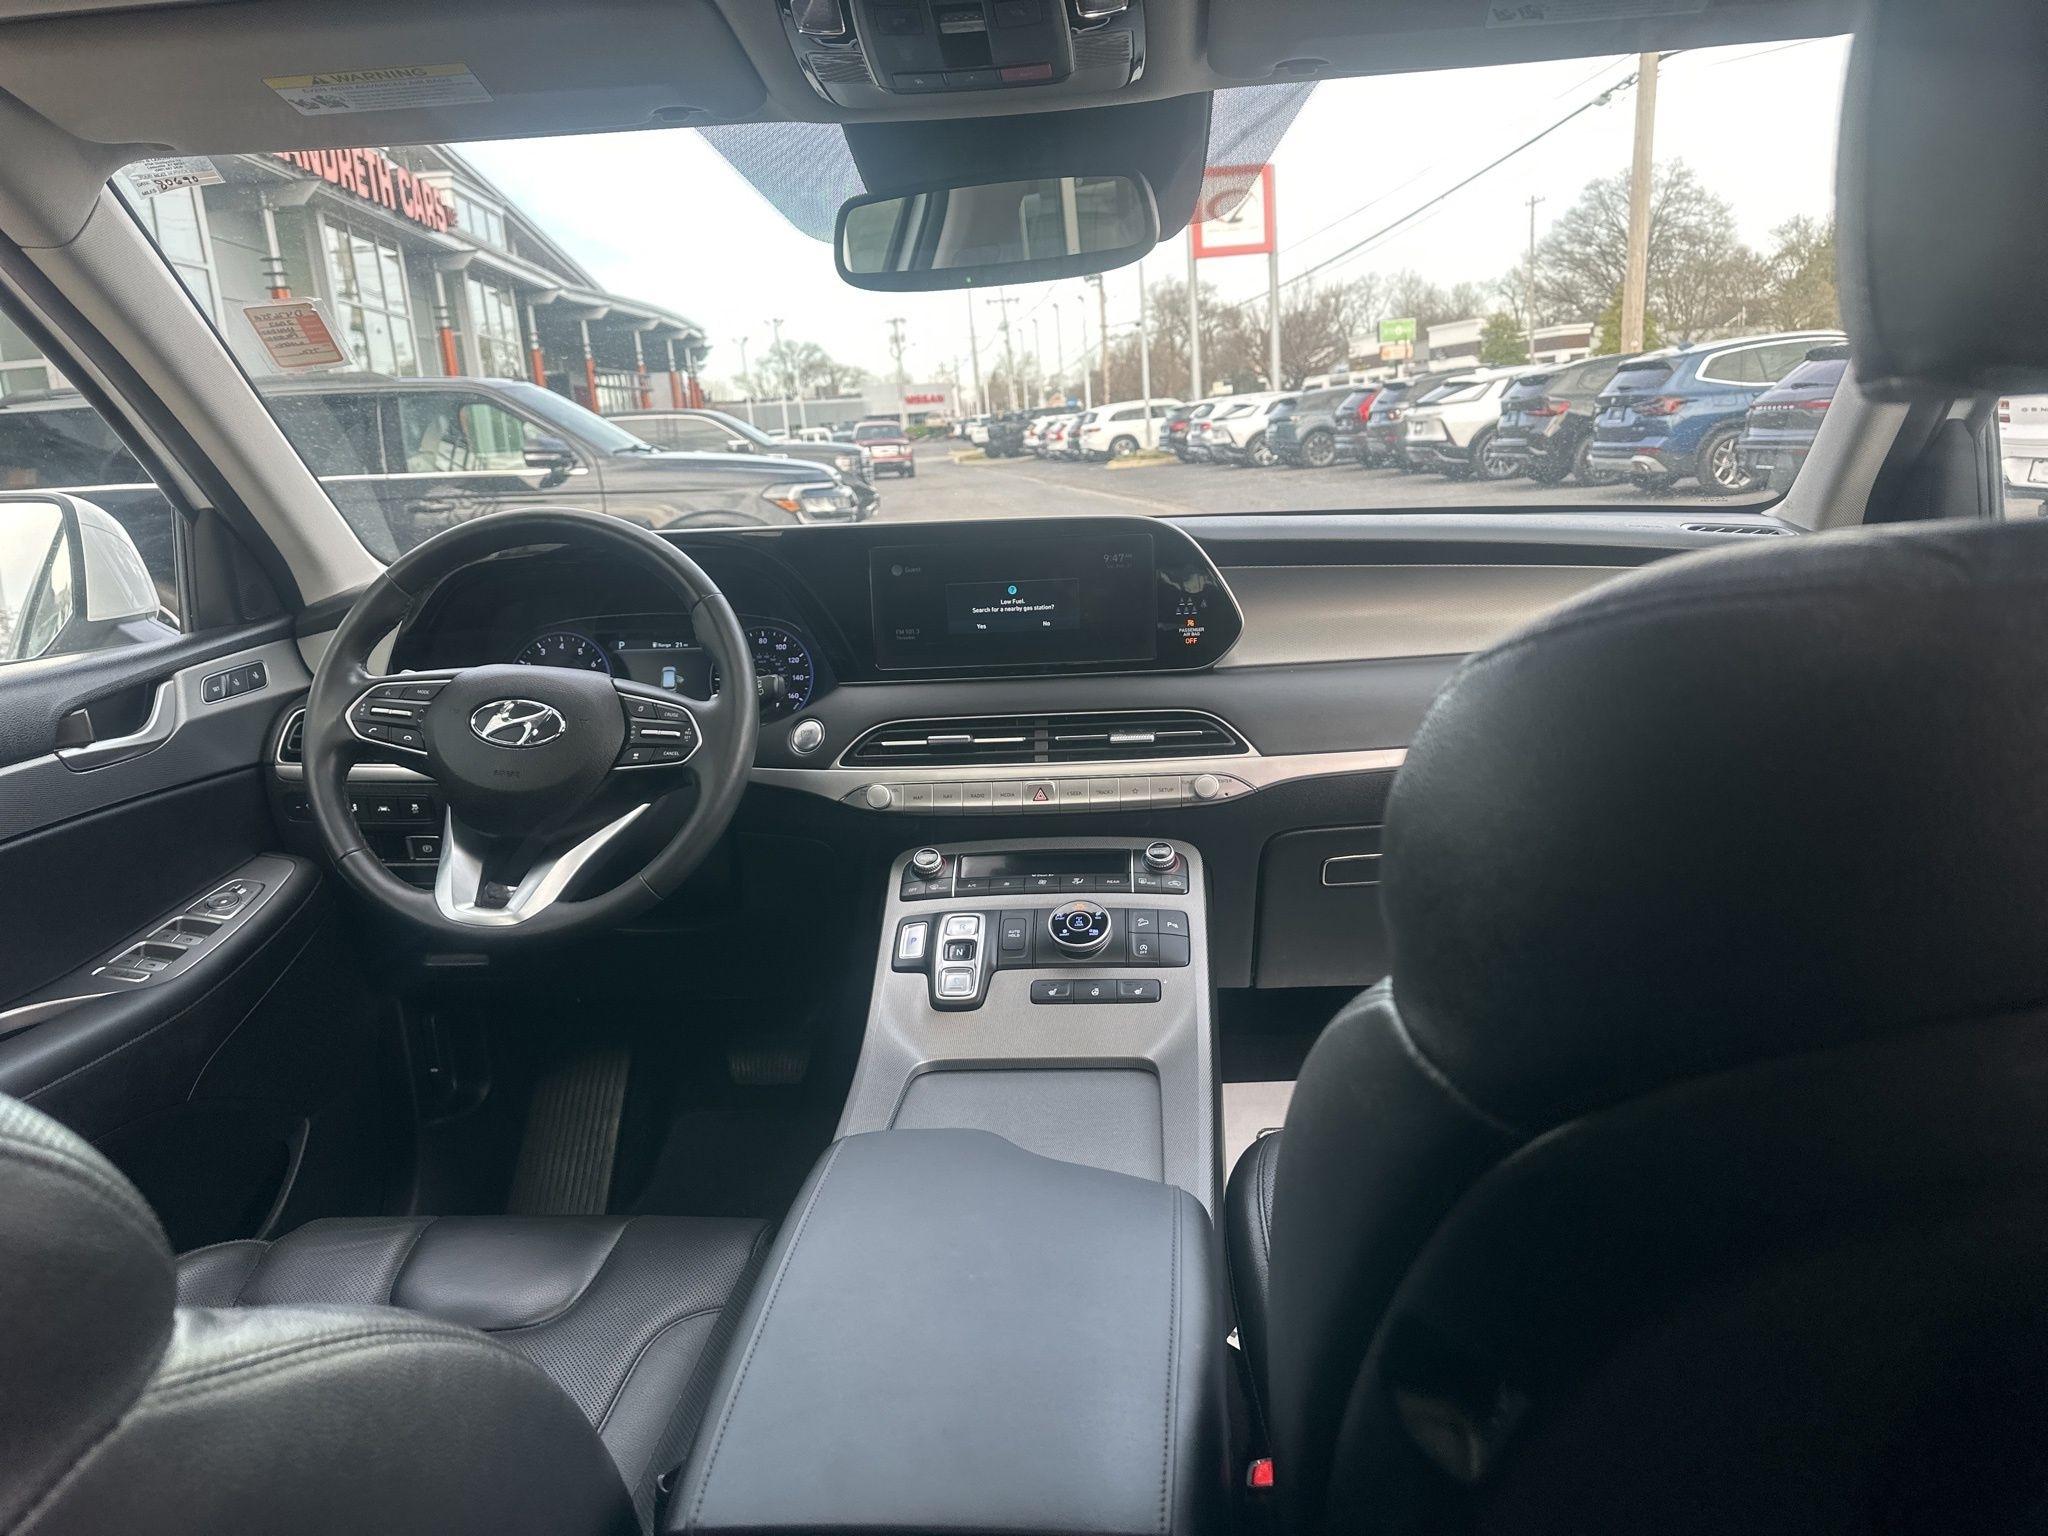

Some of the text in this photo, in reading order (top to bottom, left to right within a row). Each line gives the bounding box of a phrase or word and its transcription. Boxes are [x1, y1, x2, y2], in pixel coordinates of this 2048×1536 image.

[329, 67, 428, 84] WARNING
[273, 149, 449, 233] NDRETH CARS
[1103, 552, 1125, 563] 9:47
[618, 640, 626, 650] P
[758, 637, 768, 645] 80
[558, 642, 565, 650] 4
[775, 643, 787, 651] 100
[539, 648, 547, 656] 3
[577, 647, 584, 656] 5
[787, 656, 800, 664] 120
[590, 660, 597, 669] 6
[787, 692, 800, 700] 160
[910, 937, 917, 945] P
[956, 948, 964, 956] N
